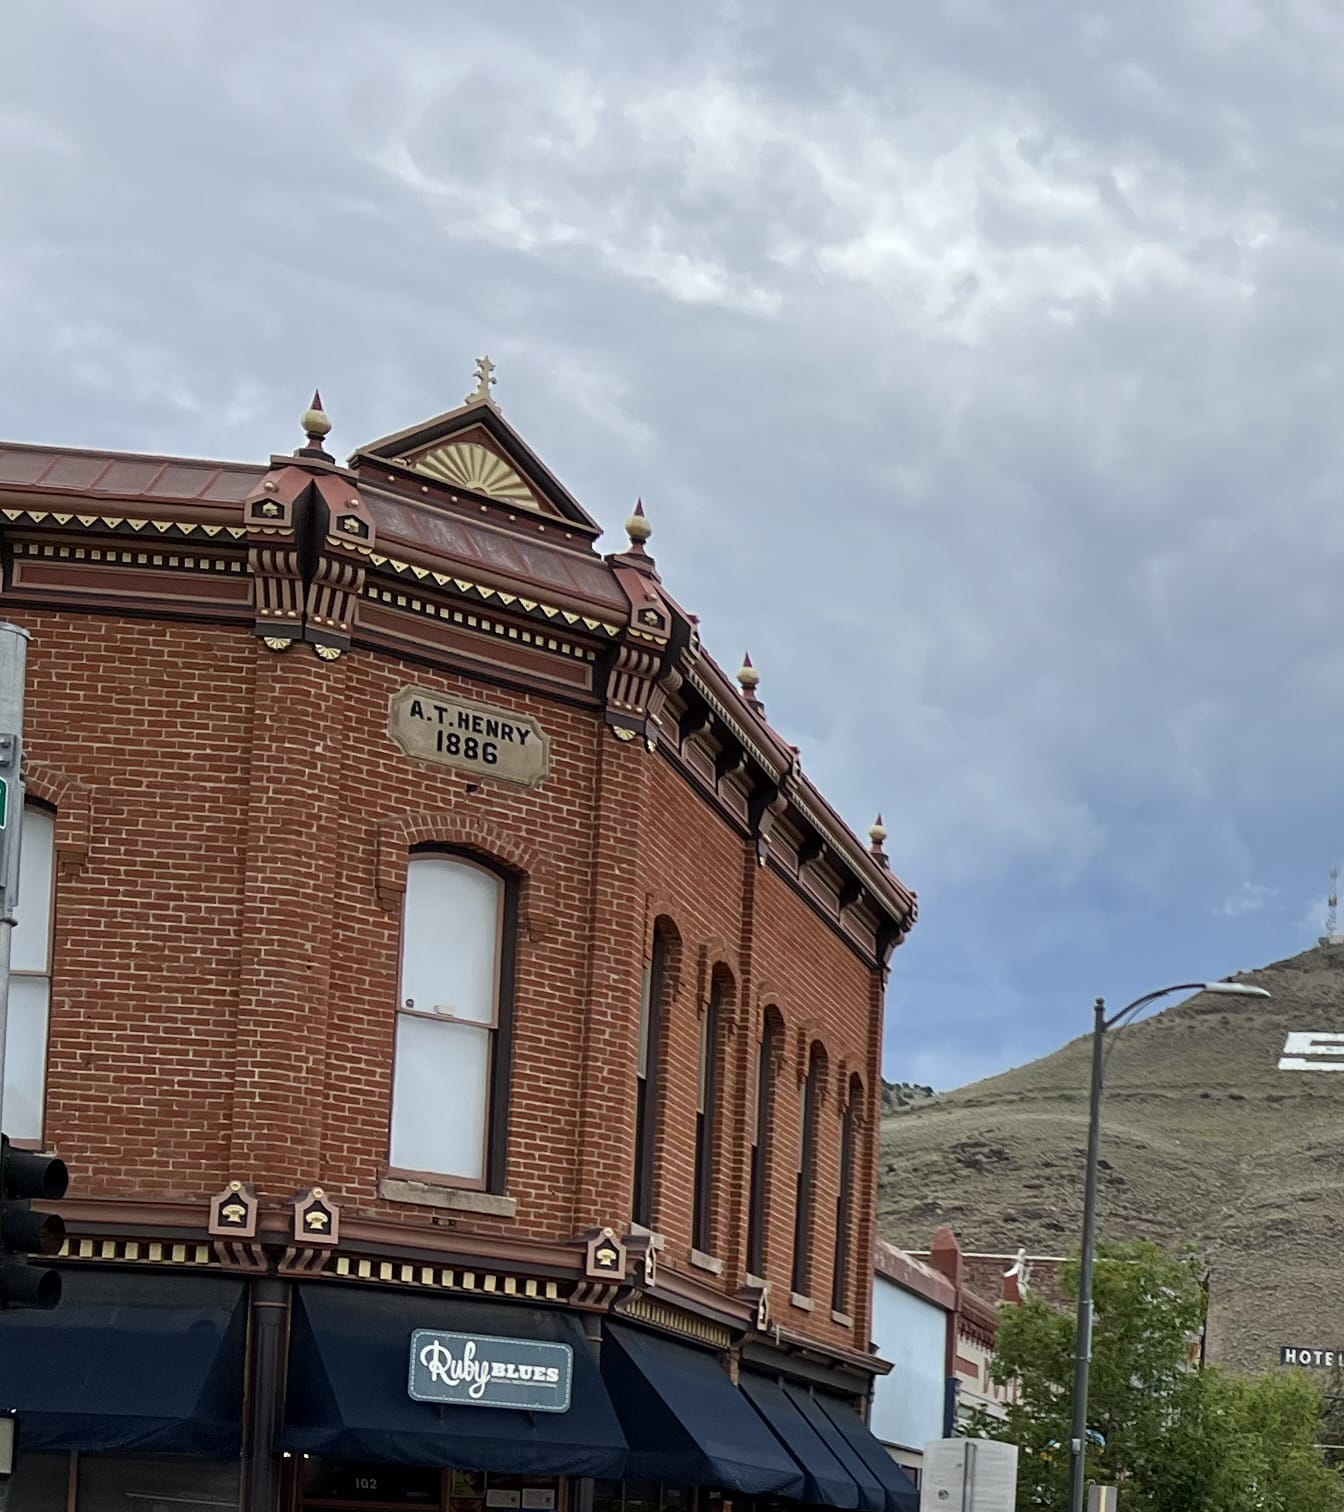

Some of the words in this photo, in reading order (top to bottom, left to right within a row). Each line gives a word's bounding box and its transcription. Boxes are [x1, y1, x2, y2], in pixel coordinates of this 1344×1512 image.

[436, 729, 498, 765] 1886
[420, 1340, 491, 1399] Ruby
[490, 1361, 560, 1383] BLUES
[1285, 1348, 1344, 1367] HOTEL
[354, 1477, 378, 1490] 102
